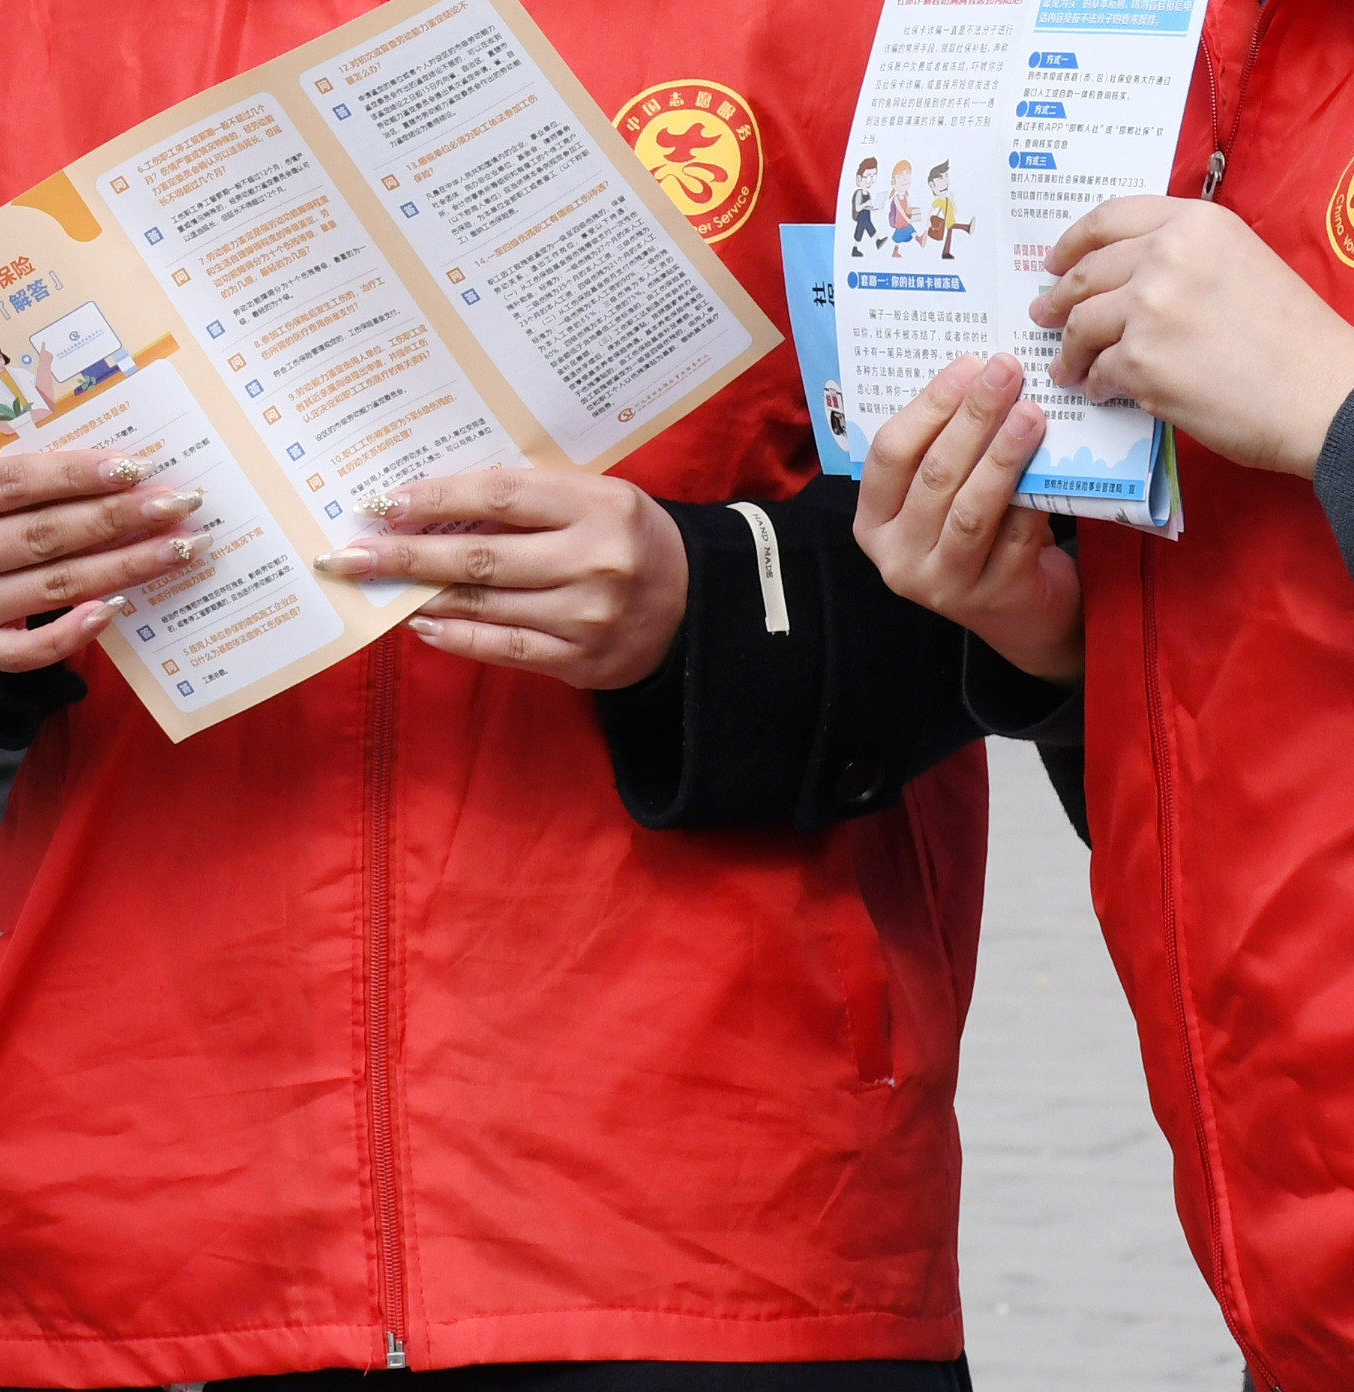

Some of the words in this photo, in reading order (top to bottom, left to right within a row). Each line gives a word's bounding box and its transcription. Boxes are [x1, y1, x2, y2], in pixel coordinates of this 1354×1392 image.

[1046, 55, 1069, 65] 方式一
[1034, 105, 1057, 115] 方式二
[1025, 156, 1047, 166] 方式三
[713, 186, 749, 228] Service
[1334, 194, 1345, 237] China
[861, 276, 960, 289] 套路一：你的社保卡被冻结
[869, 308, 988, 323] 骗子一般会通过电话或者短信通
[1044, 479, 1123, 493] 邯郸市社会保险事业管理局
[753, 513, 769, 542] HAND
[764, 547, 773, 578] MADE
